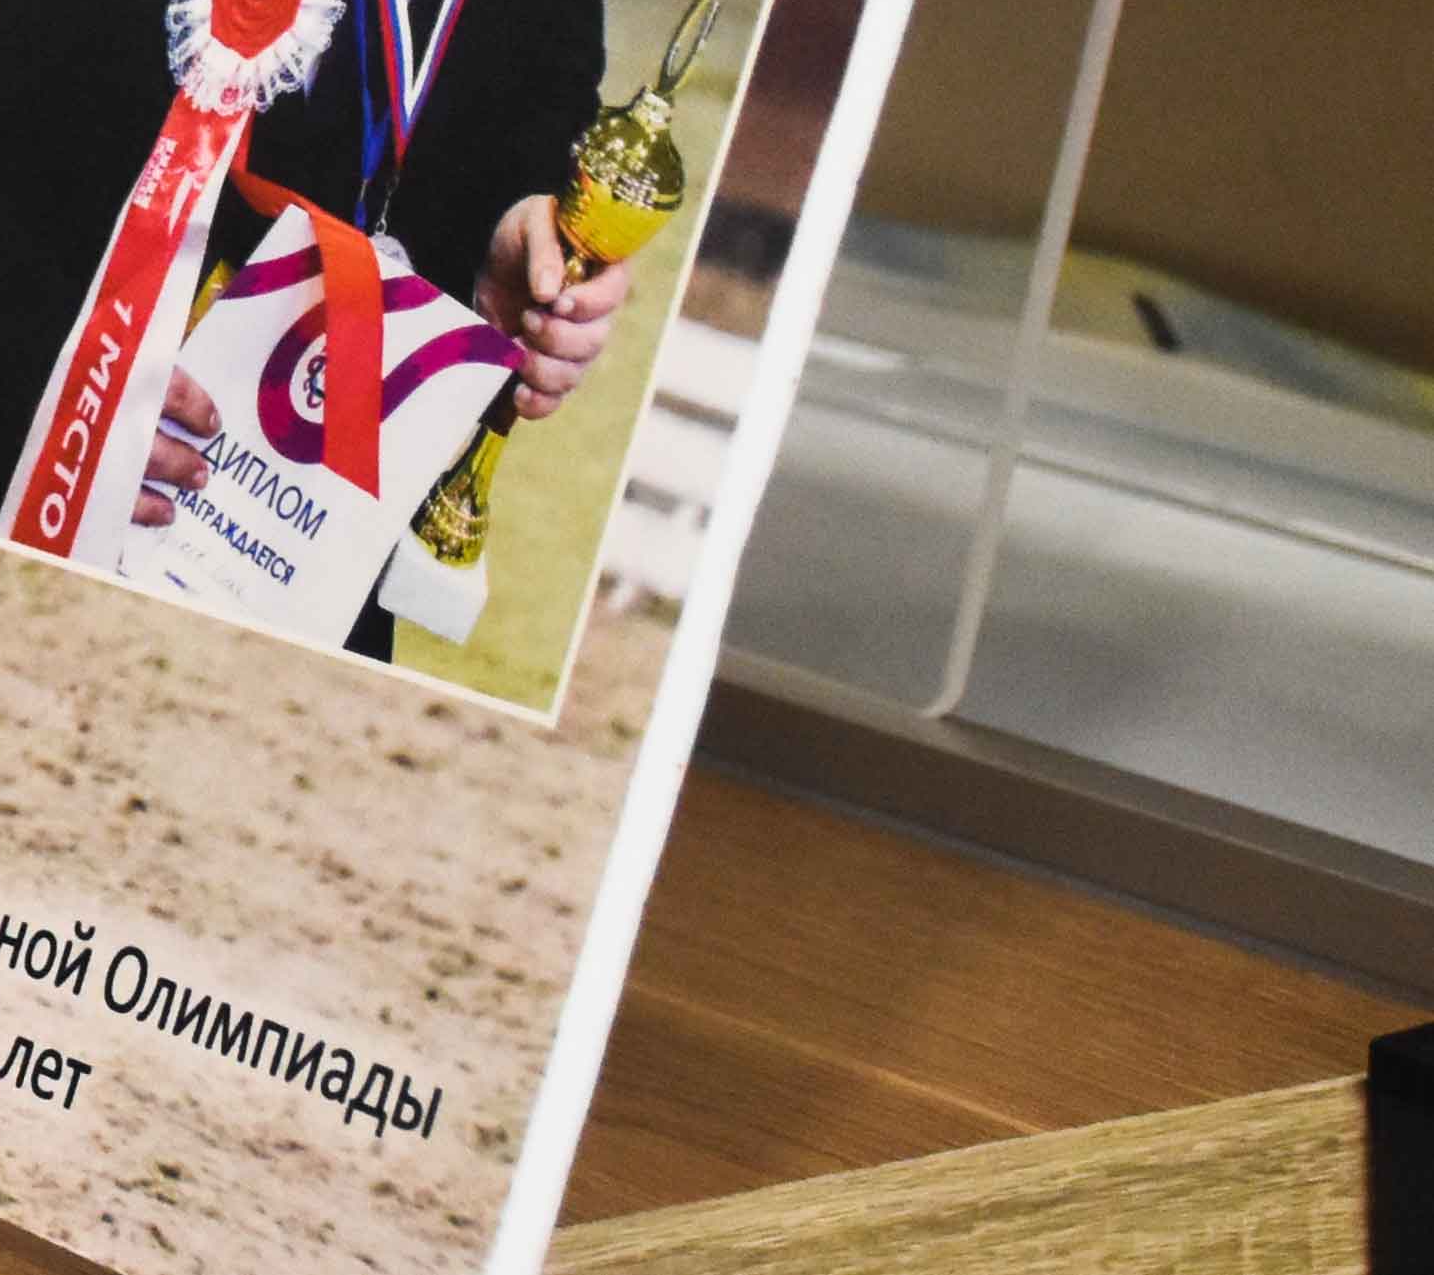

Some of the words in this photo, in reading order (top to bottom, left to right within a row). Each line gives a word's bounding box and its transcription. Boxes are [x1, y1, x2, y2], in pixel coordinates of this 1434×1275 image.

[113, 299, 134, 327] 1
[39, 332, 122, 539] МЕСТО
[200, 431, 328, 541] ДИПЛОМ
[174, 487, 296, 586] НАГРАЖДАЕТСЯ
[103, 945, 443, 1139] Олимпиады
